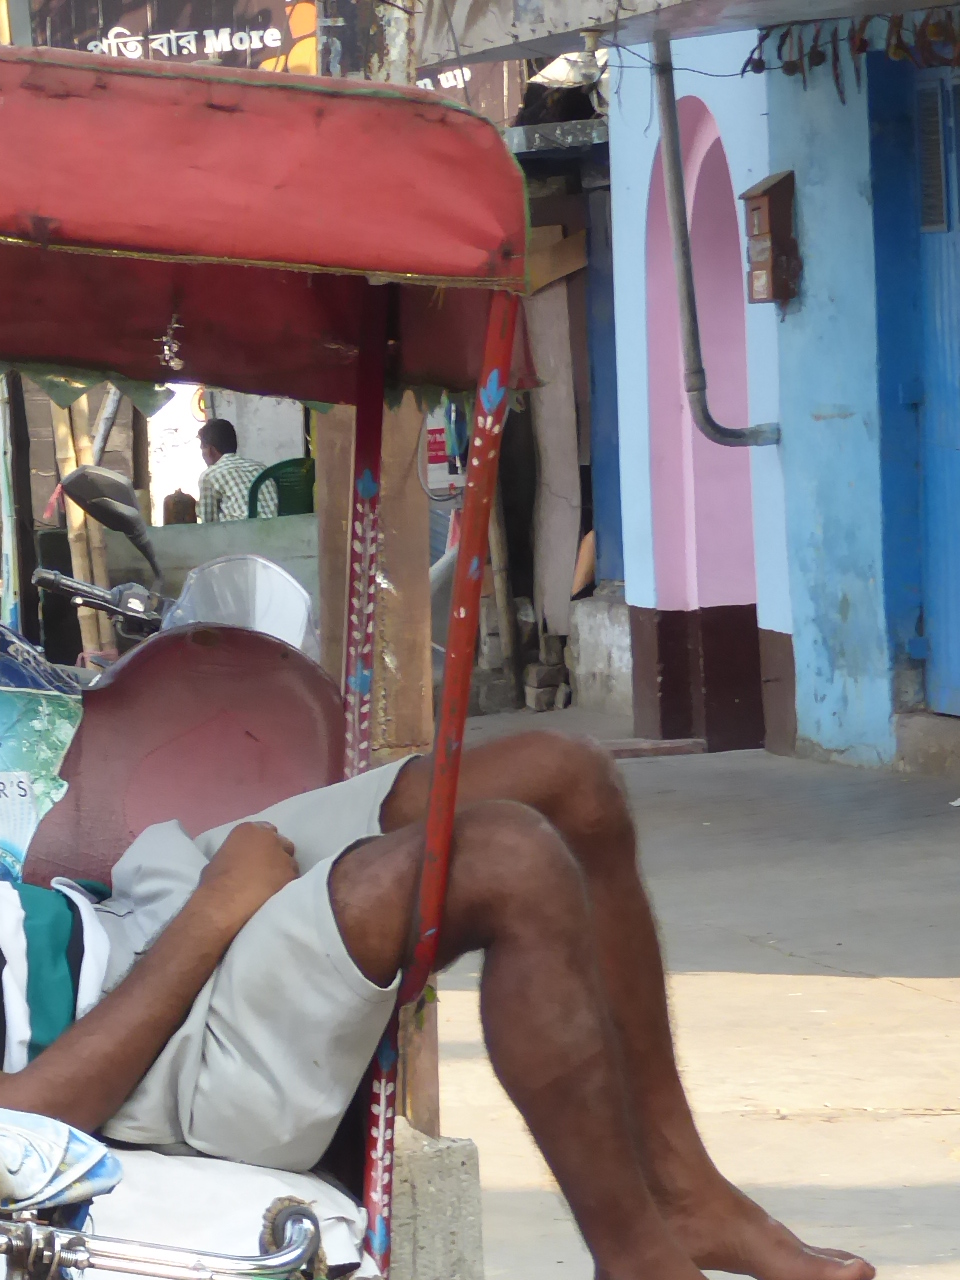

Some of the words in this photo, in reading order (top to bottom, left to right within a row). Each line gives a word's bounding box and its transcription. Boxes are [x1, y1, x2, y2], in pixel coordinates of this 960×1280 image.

[148, 30, 198, 57] বার
[202, 27, 282, 53] More
[438, 67, 471, 88] up
